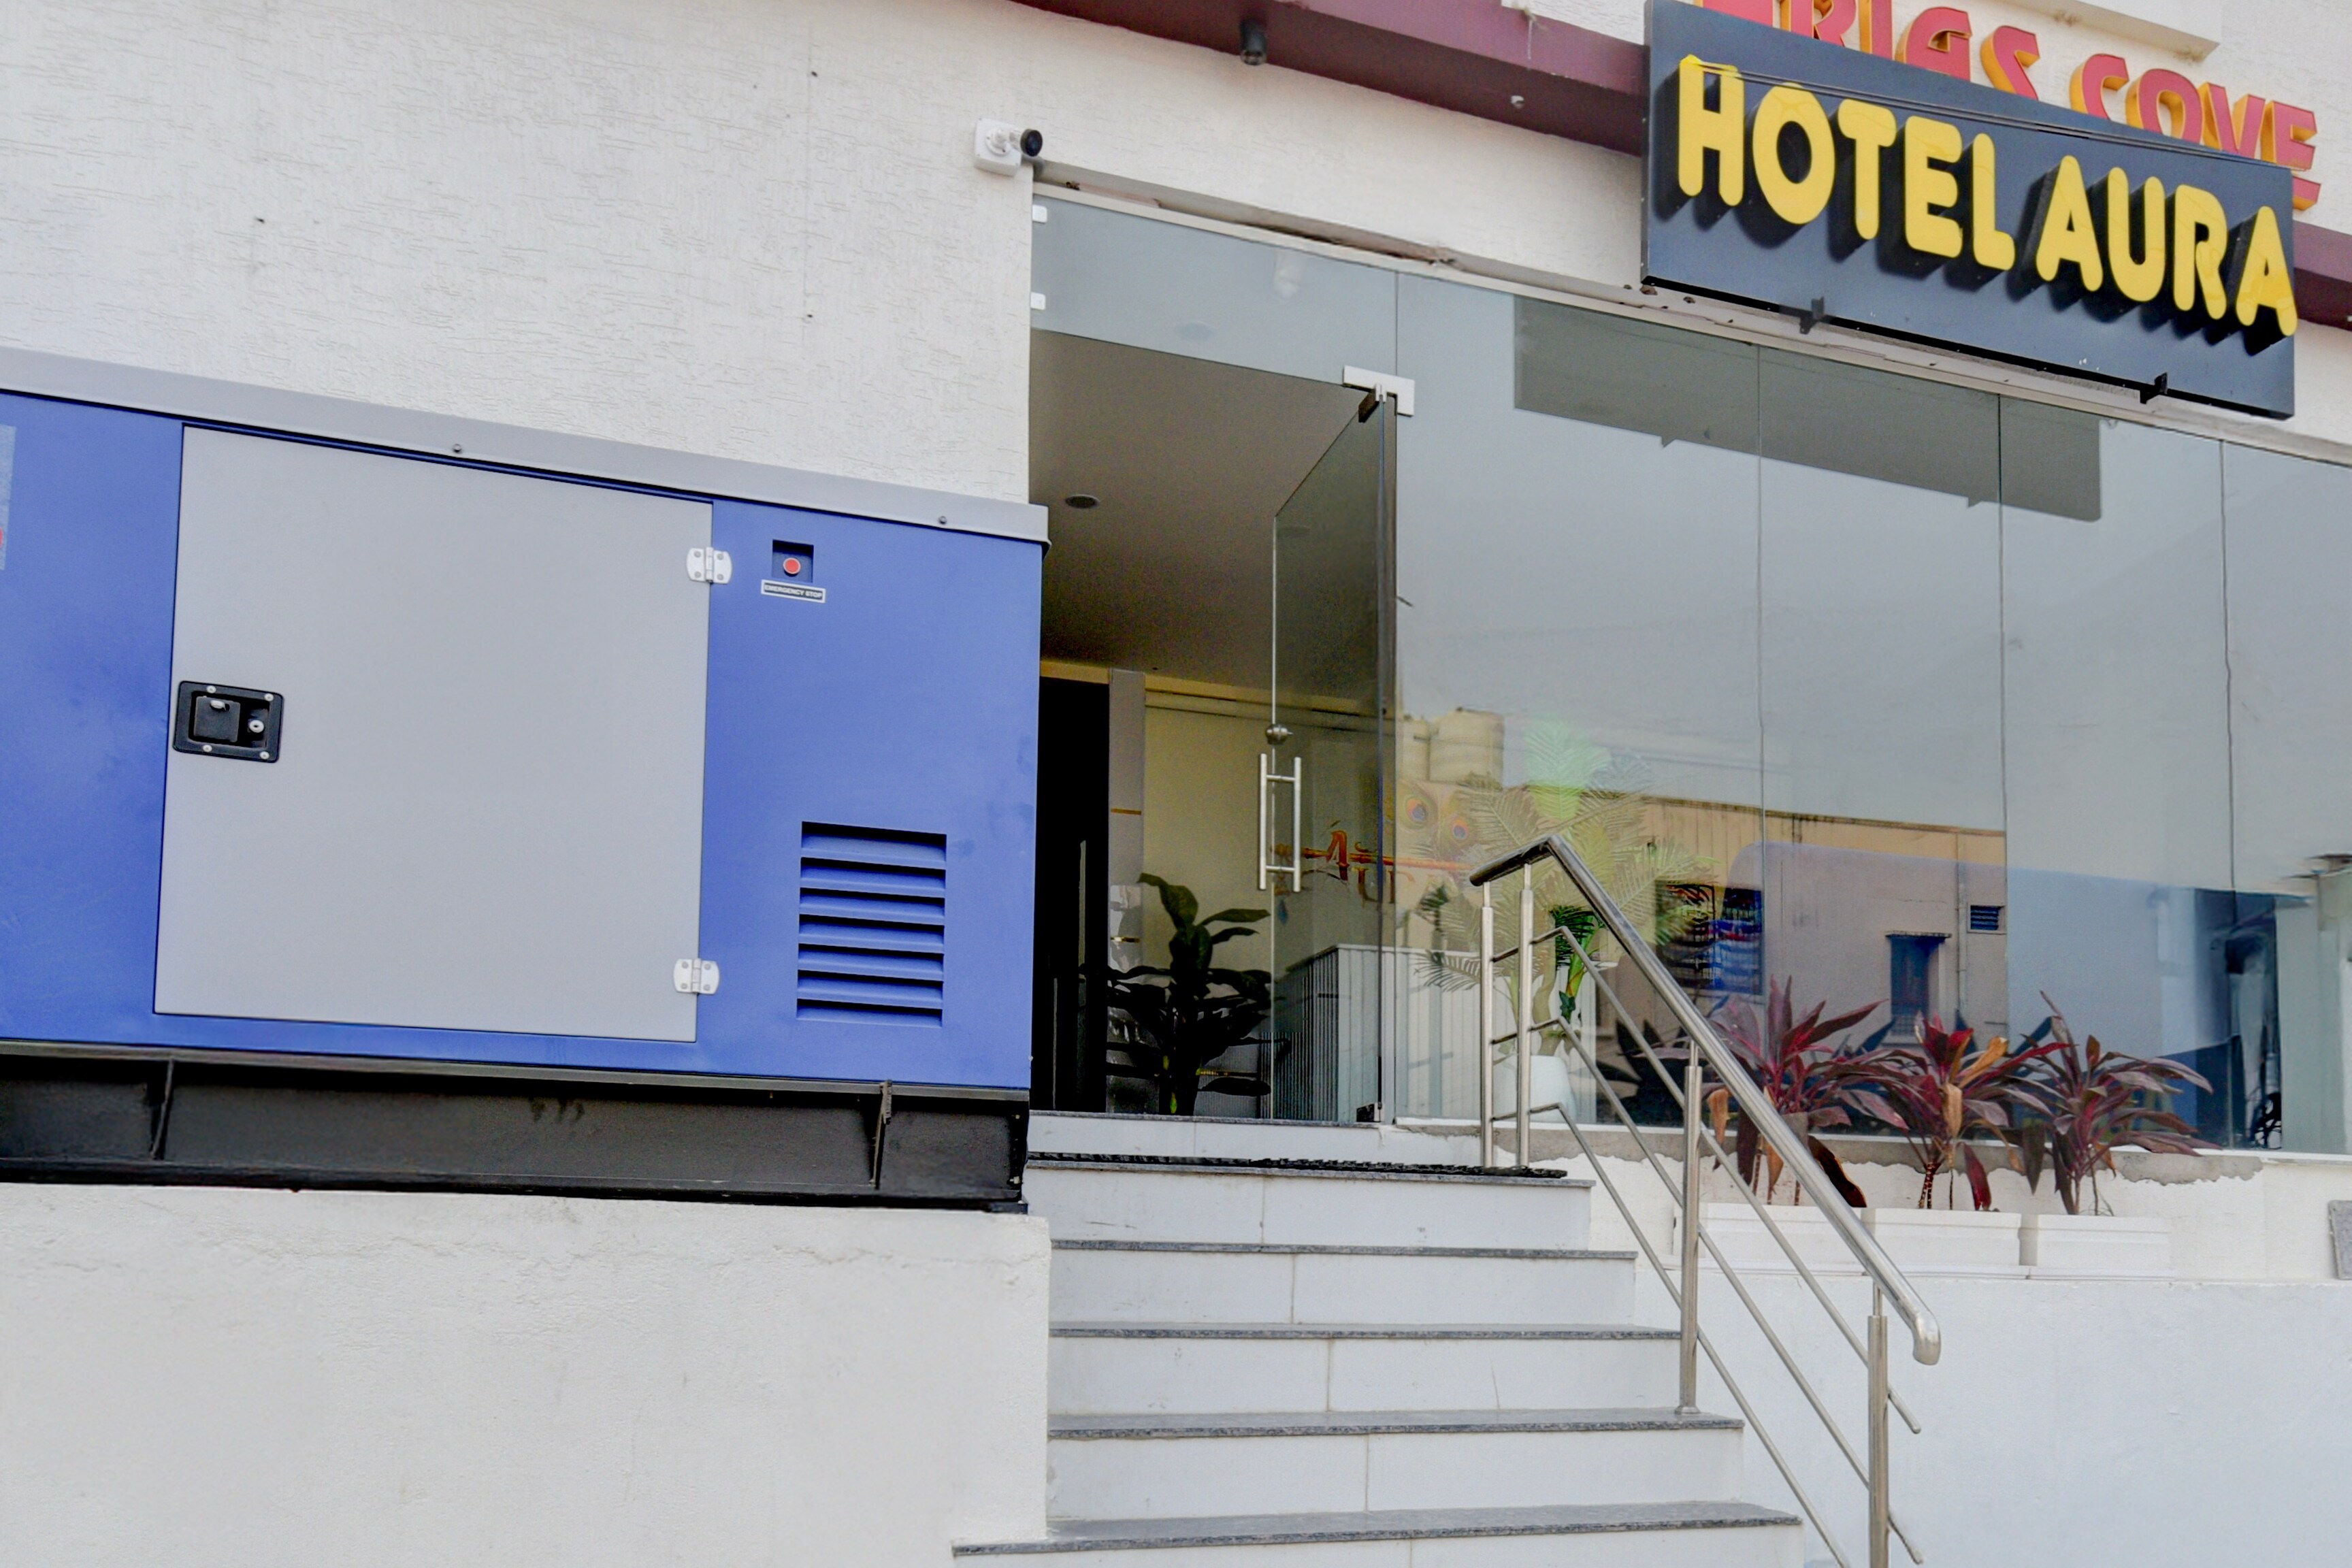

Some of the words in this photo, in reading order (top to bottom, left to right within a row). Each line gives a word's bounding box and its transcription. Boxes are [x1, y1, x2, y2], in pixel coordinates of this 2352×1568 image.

[1678, 54, 2016, 272] HOTEL
[2036, 155, 2299, 338] AURA
[805, 590, 823, 598] STOP
